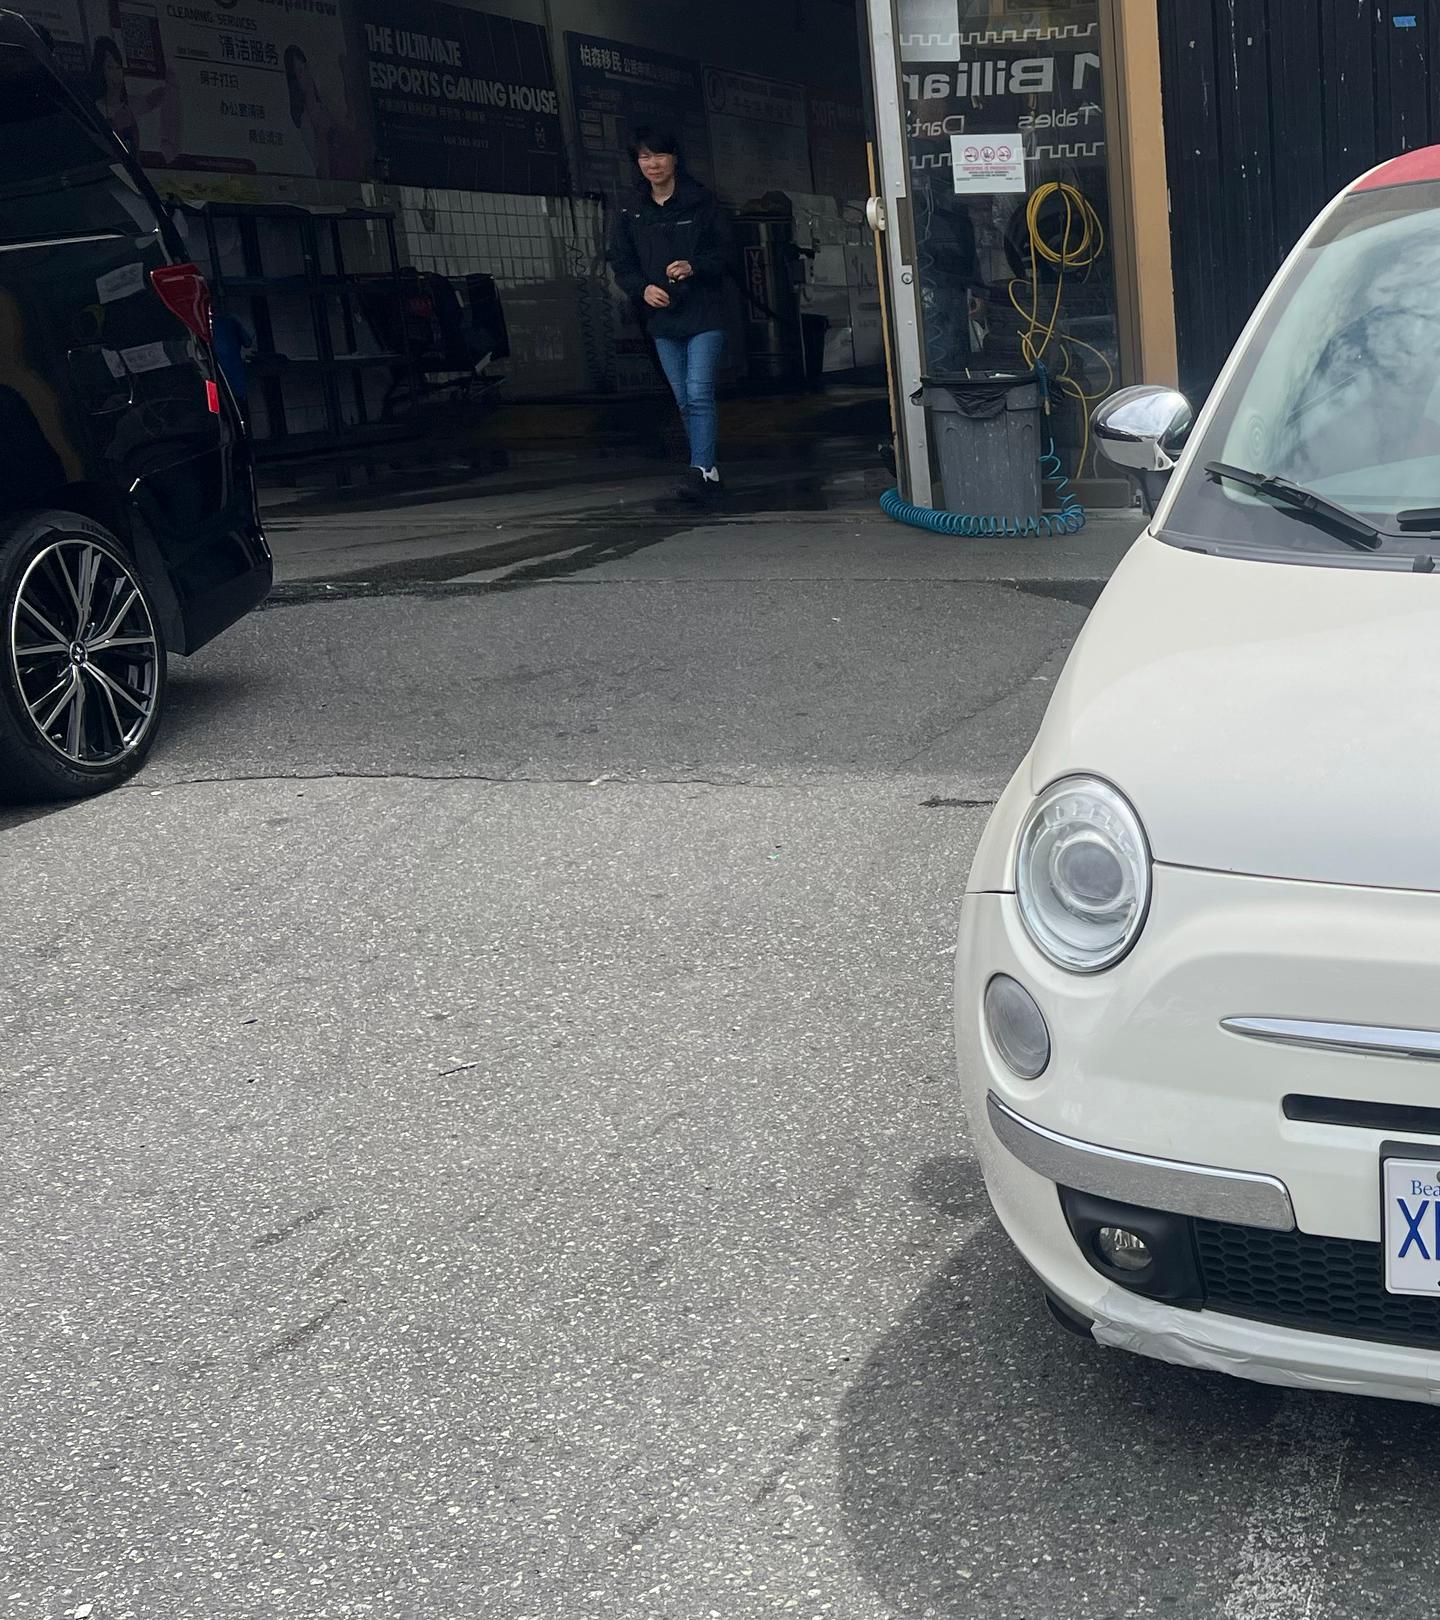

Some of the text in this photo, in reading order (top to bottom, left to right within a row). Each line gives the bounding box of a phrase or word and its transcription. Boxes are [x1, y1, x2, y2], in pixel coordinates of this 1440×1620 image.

[215, 13, 258, 30] SERVICES
[218, 33, 280, 65] 清洁服务
[364, 23, 464, 67] THE ULTIMATE
[368, 60, 441, 97] ESPORTS
[442, 73, 507, 108] GAMING
[509, 84, 559, 115] HOUSE
